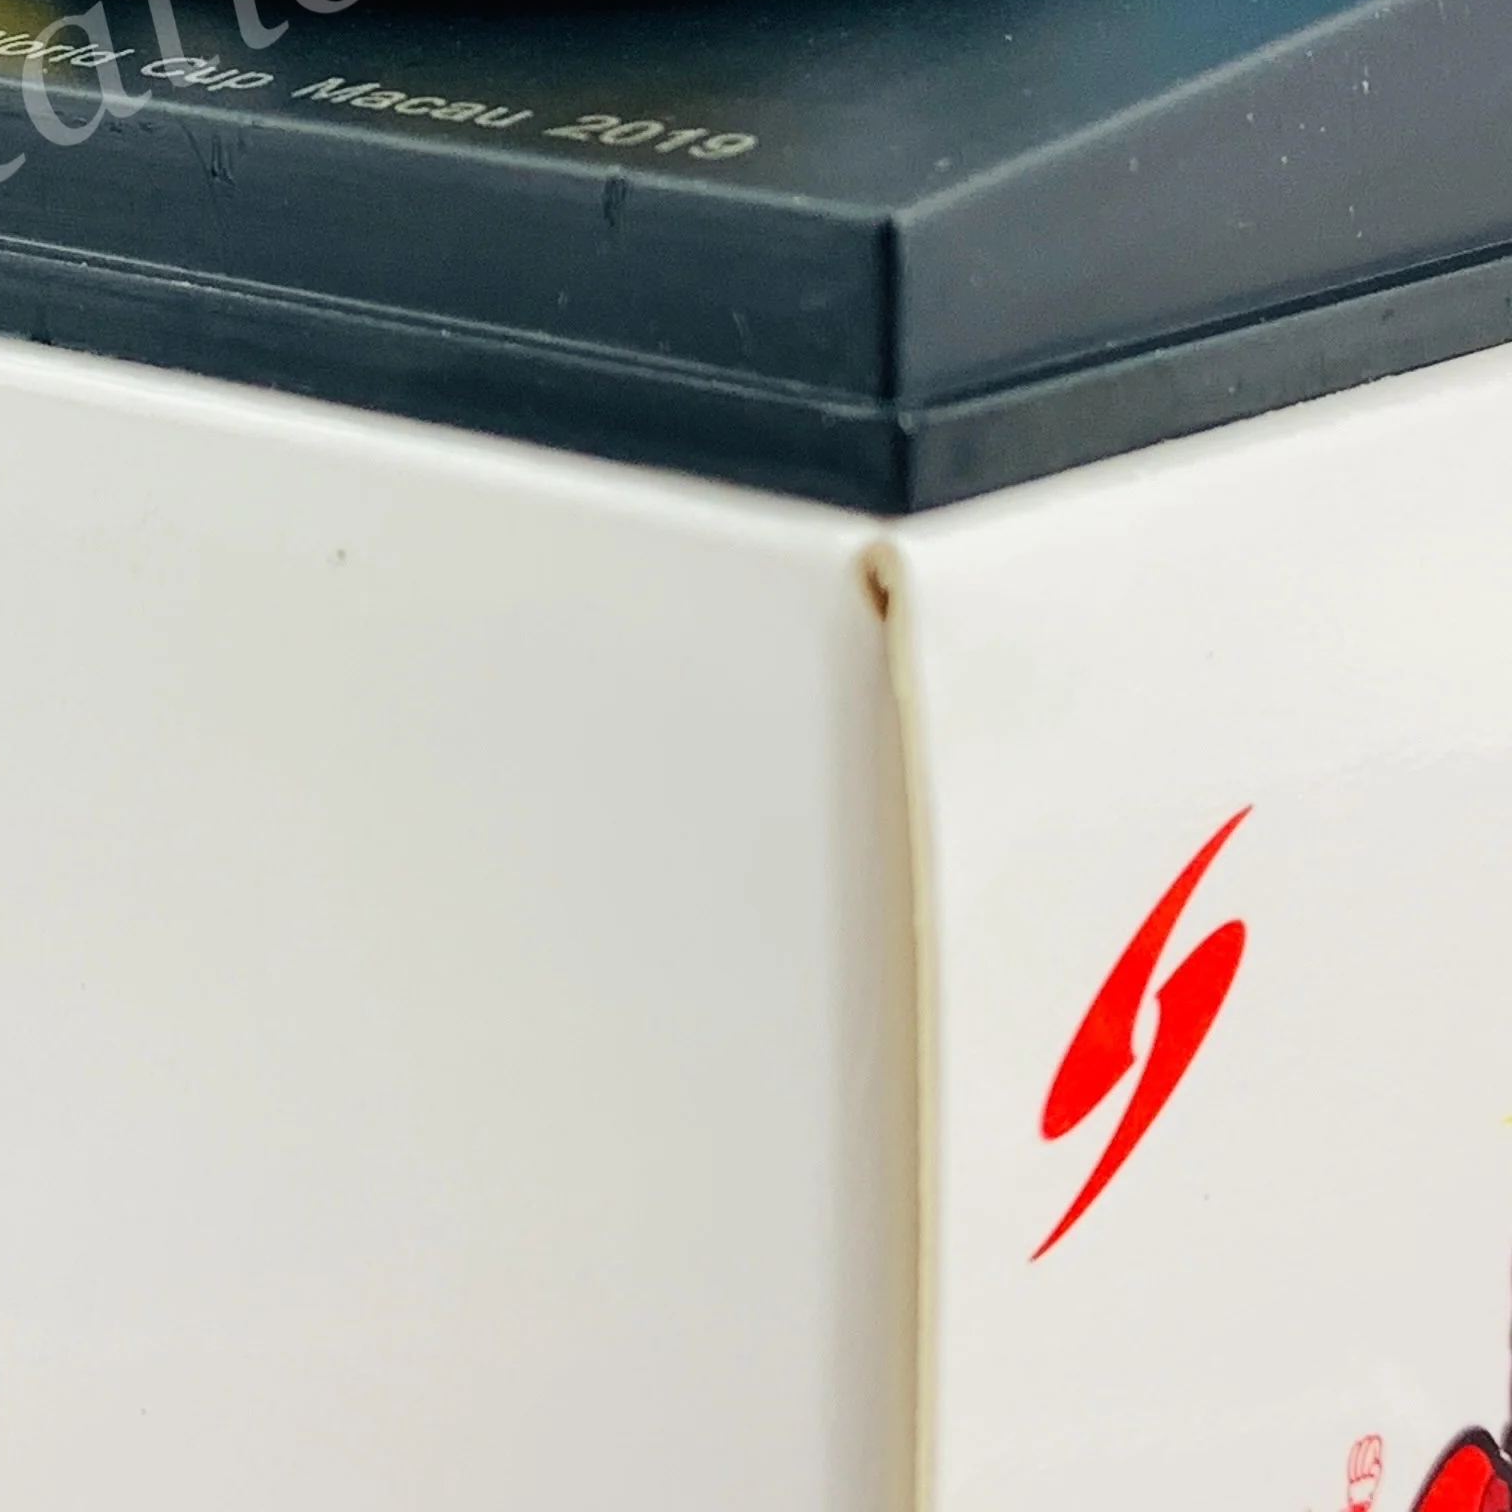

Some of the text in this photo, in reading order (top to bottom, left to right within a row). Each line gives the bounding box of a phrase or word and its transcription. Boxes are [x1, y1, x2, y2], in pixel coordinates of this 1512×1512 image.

[140, 56, 275, 92] Cup
[291, 75, 534, 129] Macau
[543, 113, 759, 161] 2019
